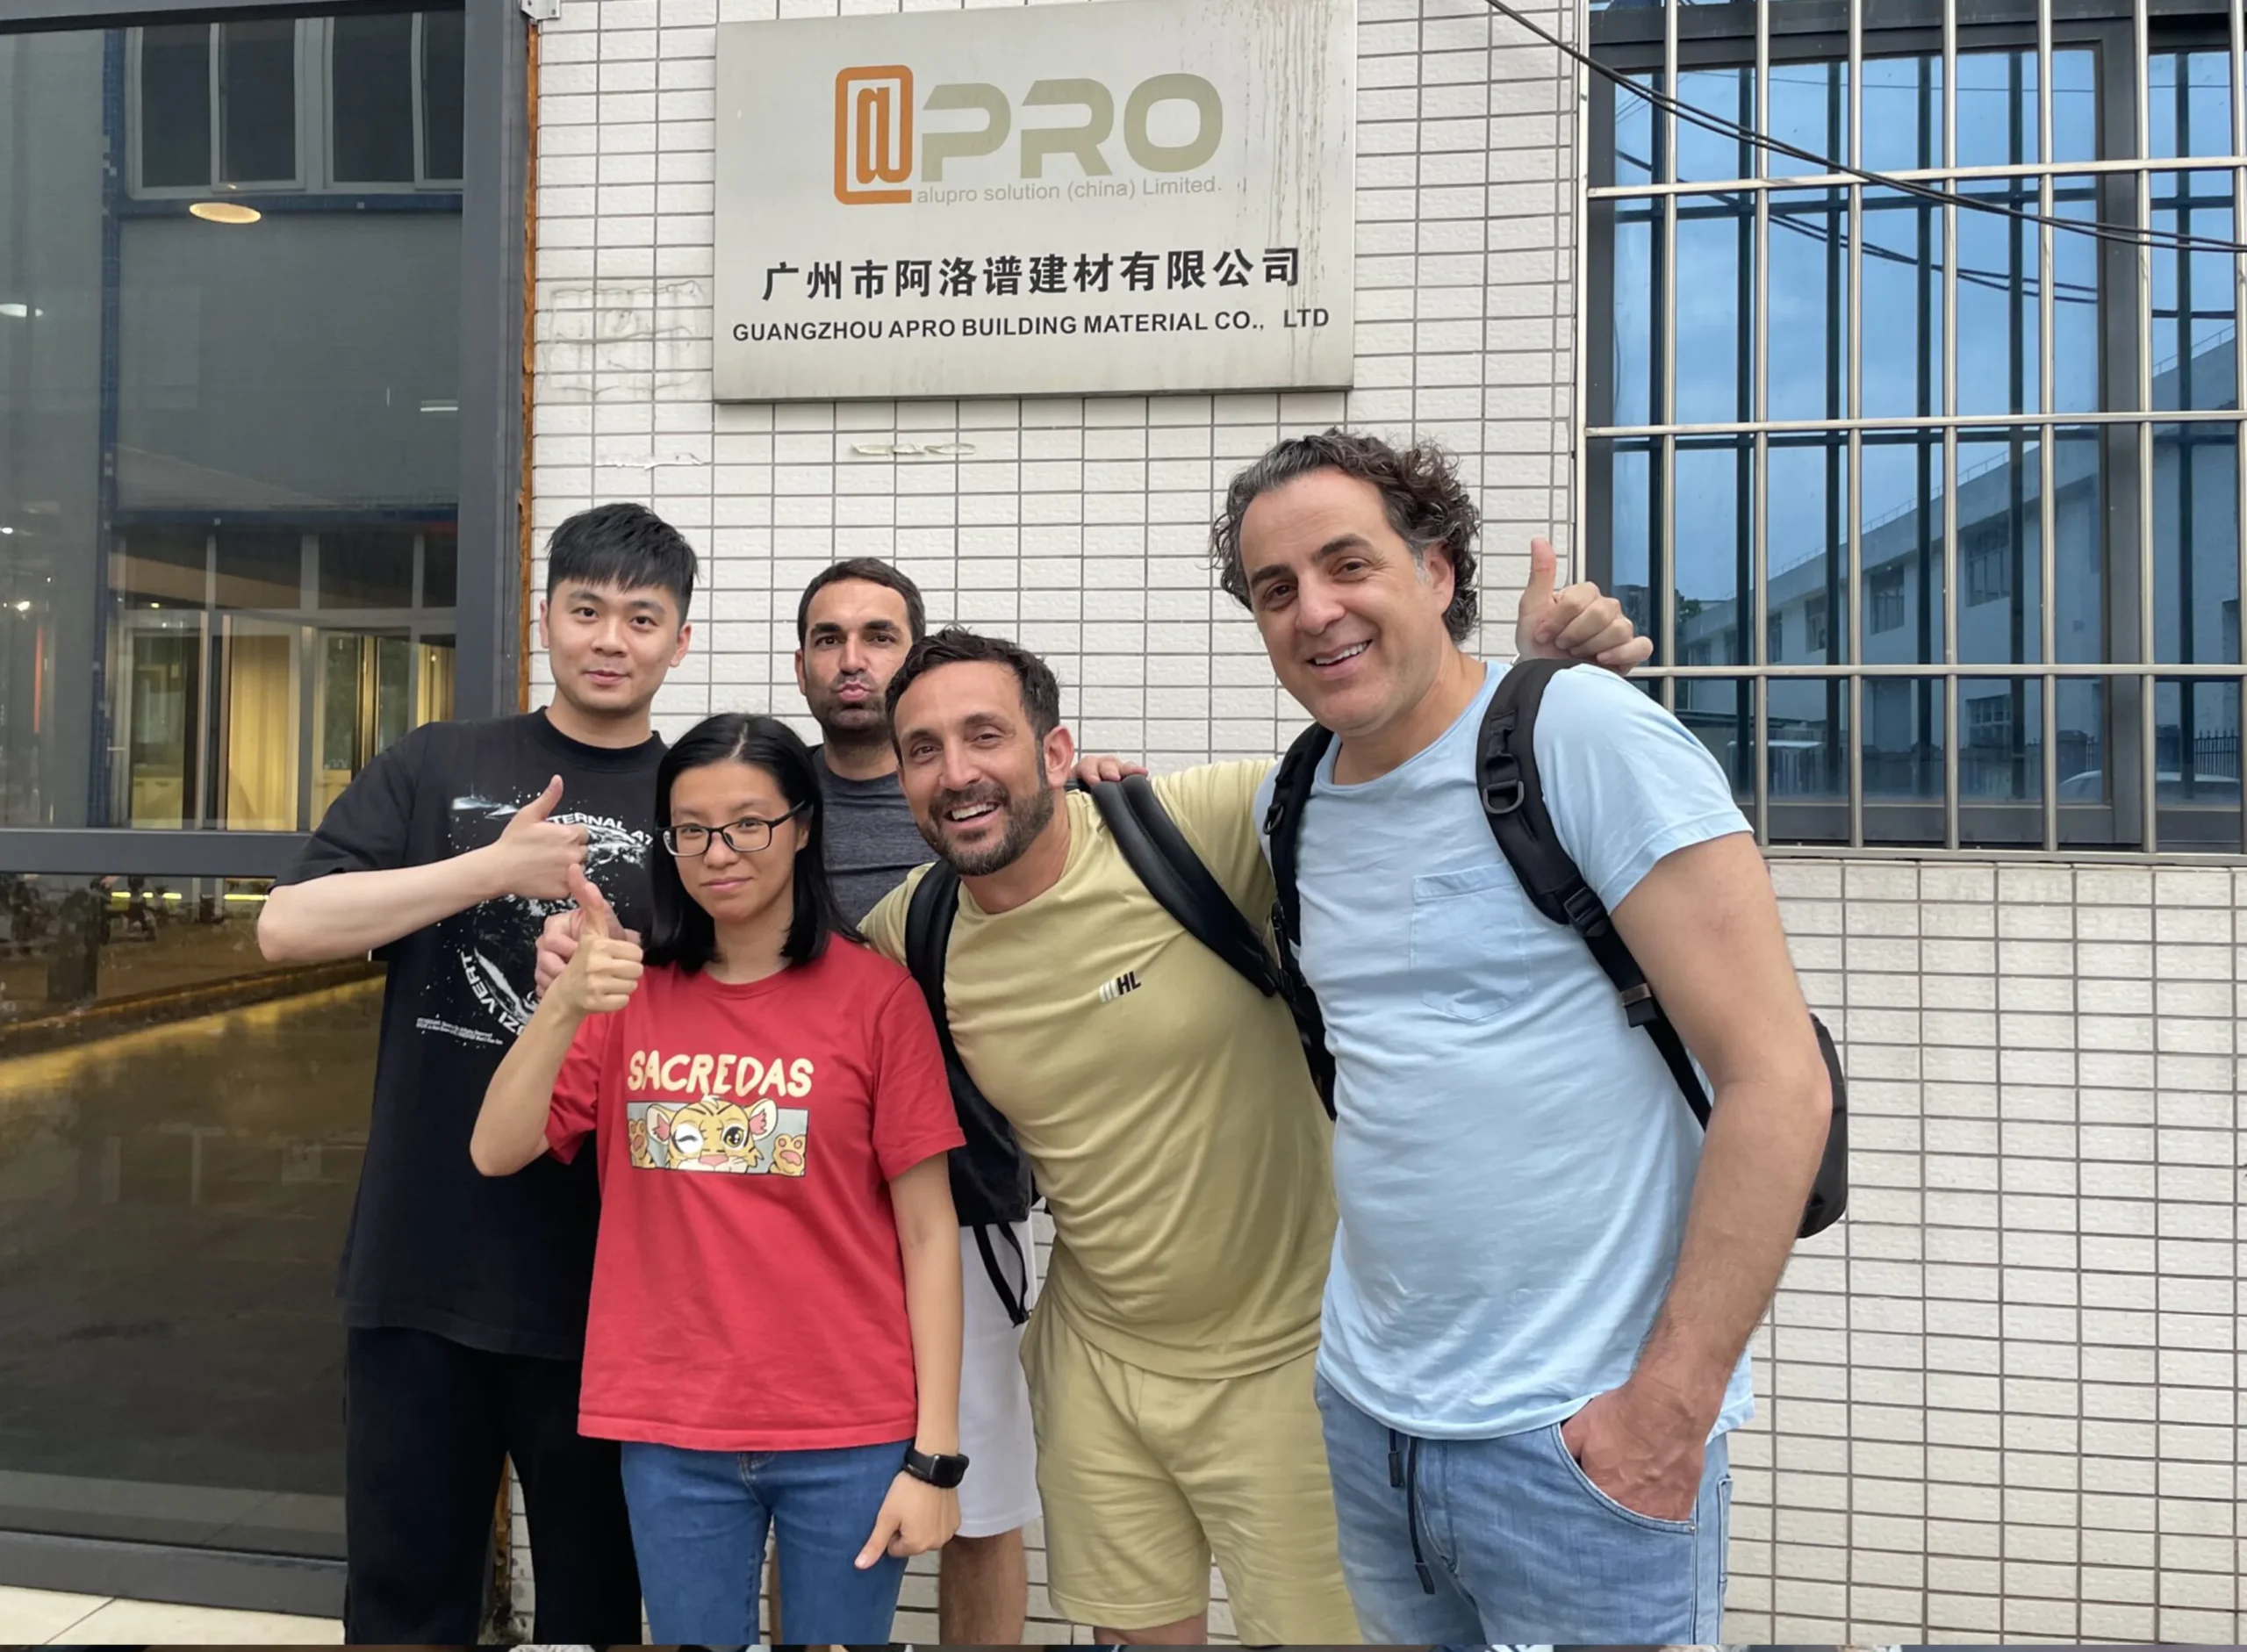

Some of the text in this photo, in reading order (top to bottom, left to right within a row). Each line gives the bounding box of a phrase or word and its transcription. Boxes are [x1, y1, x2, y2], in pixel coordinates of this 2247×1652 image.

[917, 176, 1223, 205] alupro solution (china) Limited.
[762, 248, 1299, 301] 广州市阿洛谱建材有限公司
[733, 320, 883, 341] GUANGZHOU
[888, 319, 956, 339] APRO
[962, 316, 1077, 337] BUILDING
[1084, 312, 1209, 334] MATERIAL
[1282, 308, 1330, 328] LTD
[545, 812, 628, 834] TERNAL
[460, 951, 496, 1015] VERT
[627, 1049, 815, 1098] SACREDAS
